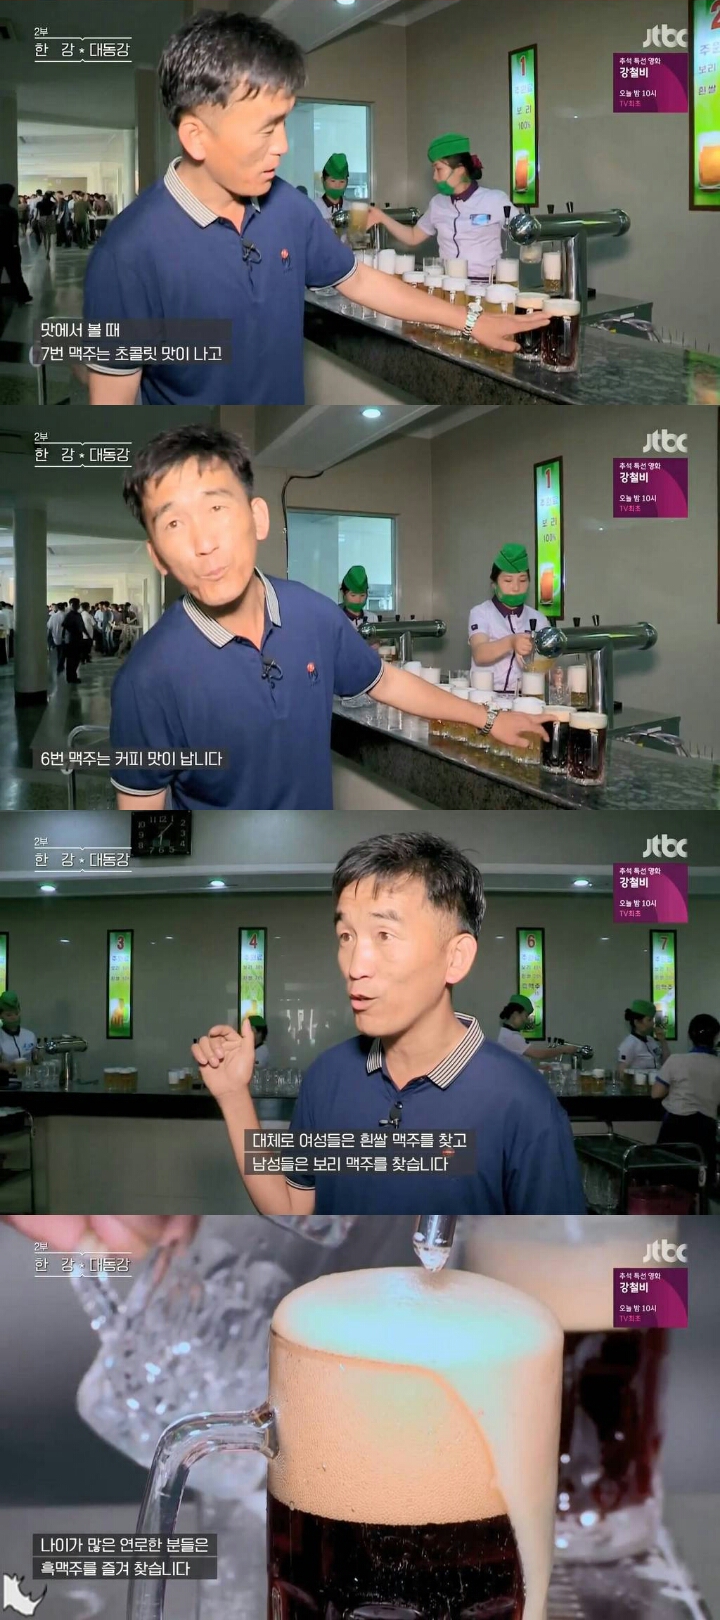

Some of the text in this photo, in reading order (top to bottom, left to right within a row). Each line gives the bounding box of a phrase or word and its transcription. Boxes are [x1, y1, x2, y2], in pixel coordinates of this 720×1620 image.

[544, 468, 552, 489] 1
[117, 936, 126, 951] 3
[249, 933, 258, 949] 4
[526, 934, 536, 949] 6
[660, 936, 668, 950] 7
